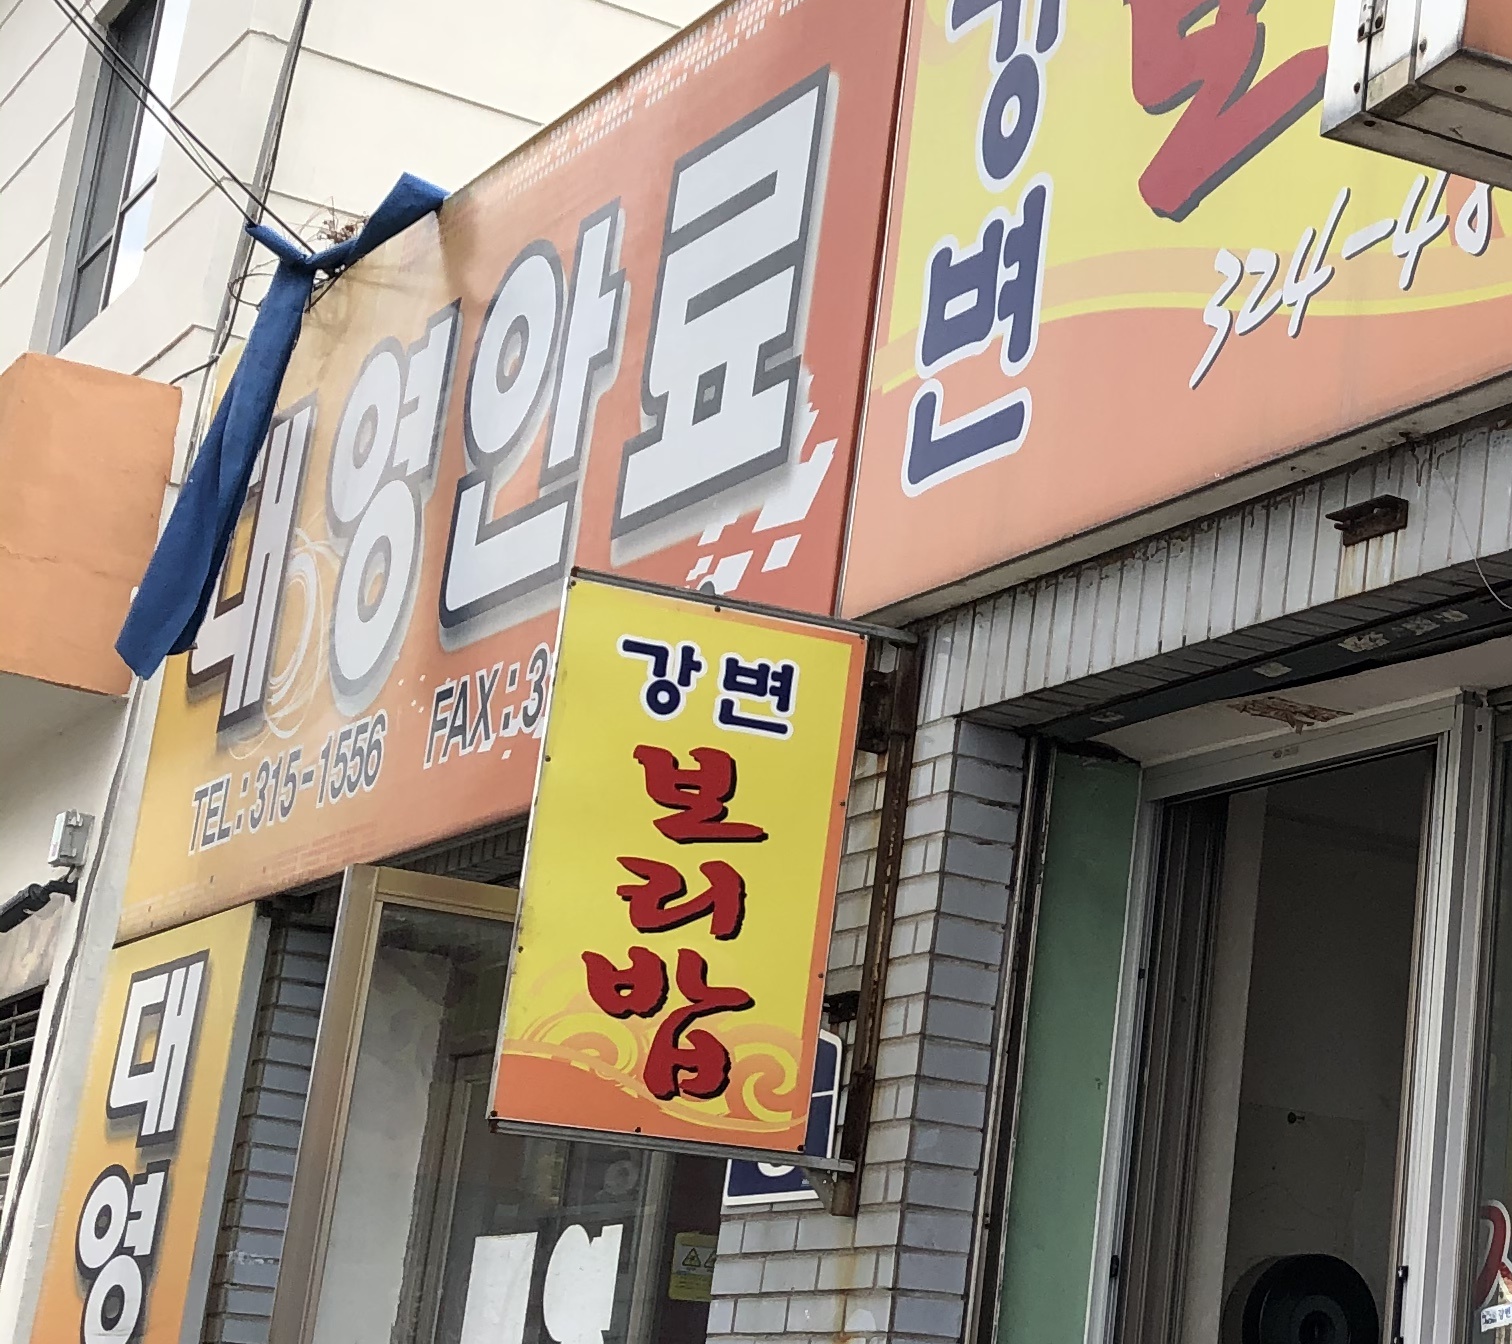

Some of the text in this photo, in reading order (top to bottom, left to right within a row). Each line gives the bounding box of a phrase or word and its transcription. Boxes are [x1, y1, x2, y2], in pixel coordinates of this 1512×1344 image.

[187, 65, 832, 735] 대영안료
[619, 636, 797, 738] 강변
[582, 744, 770, 1102] 보리밥
